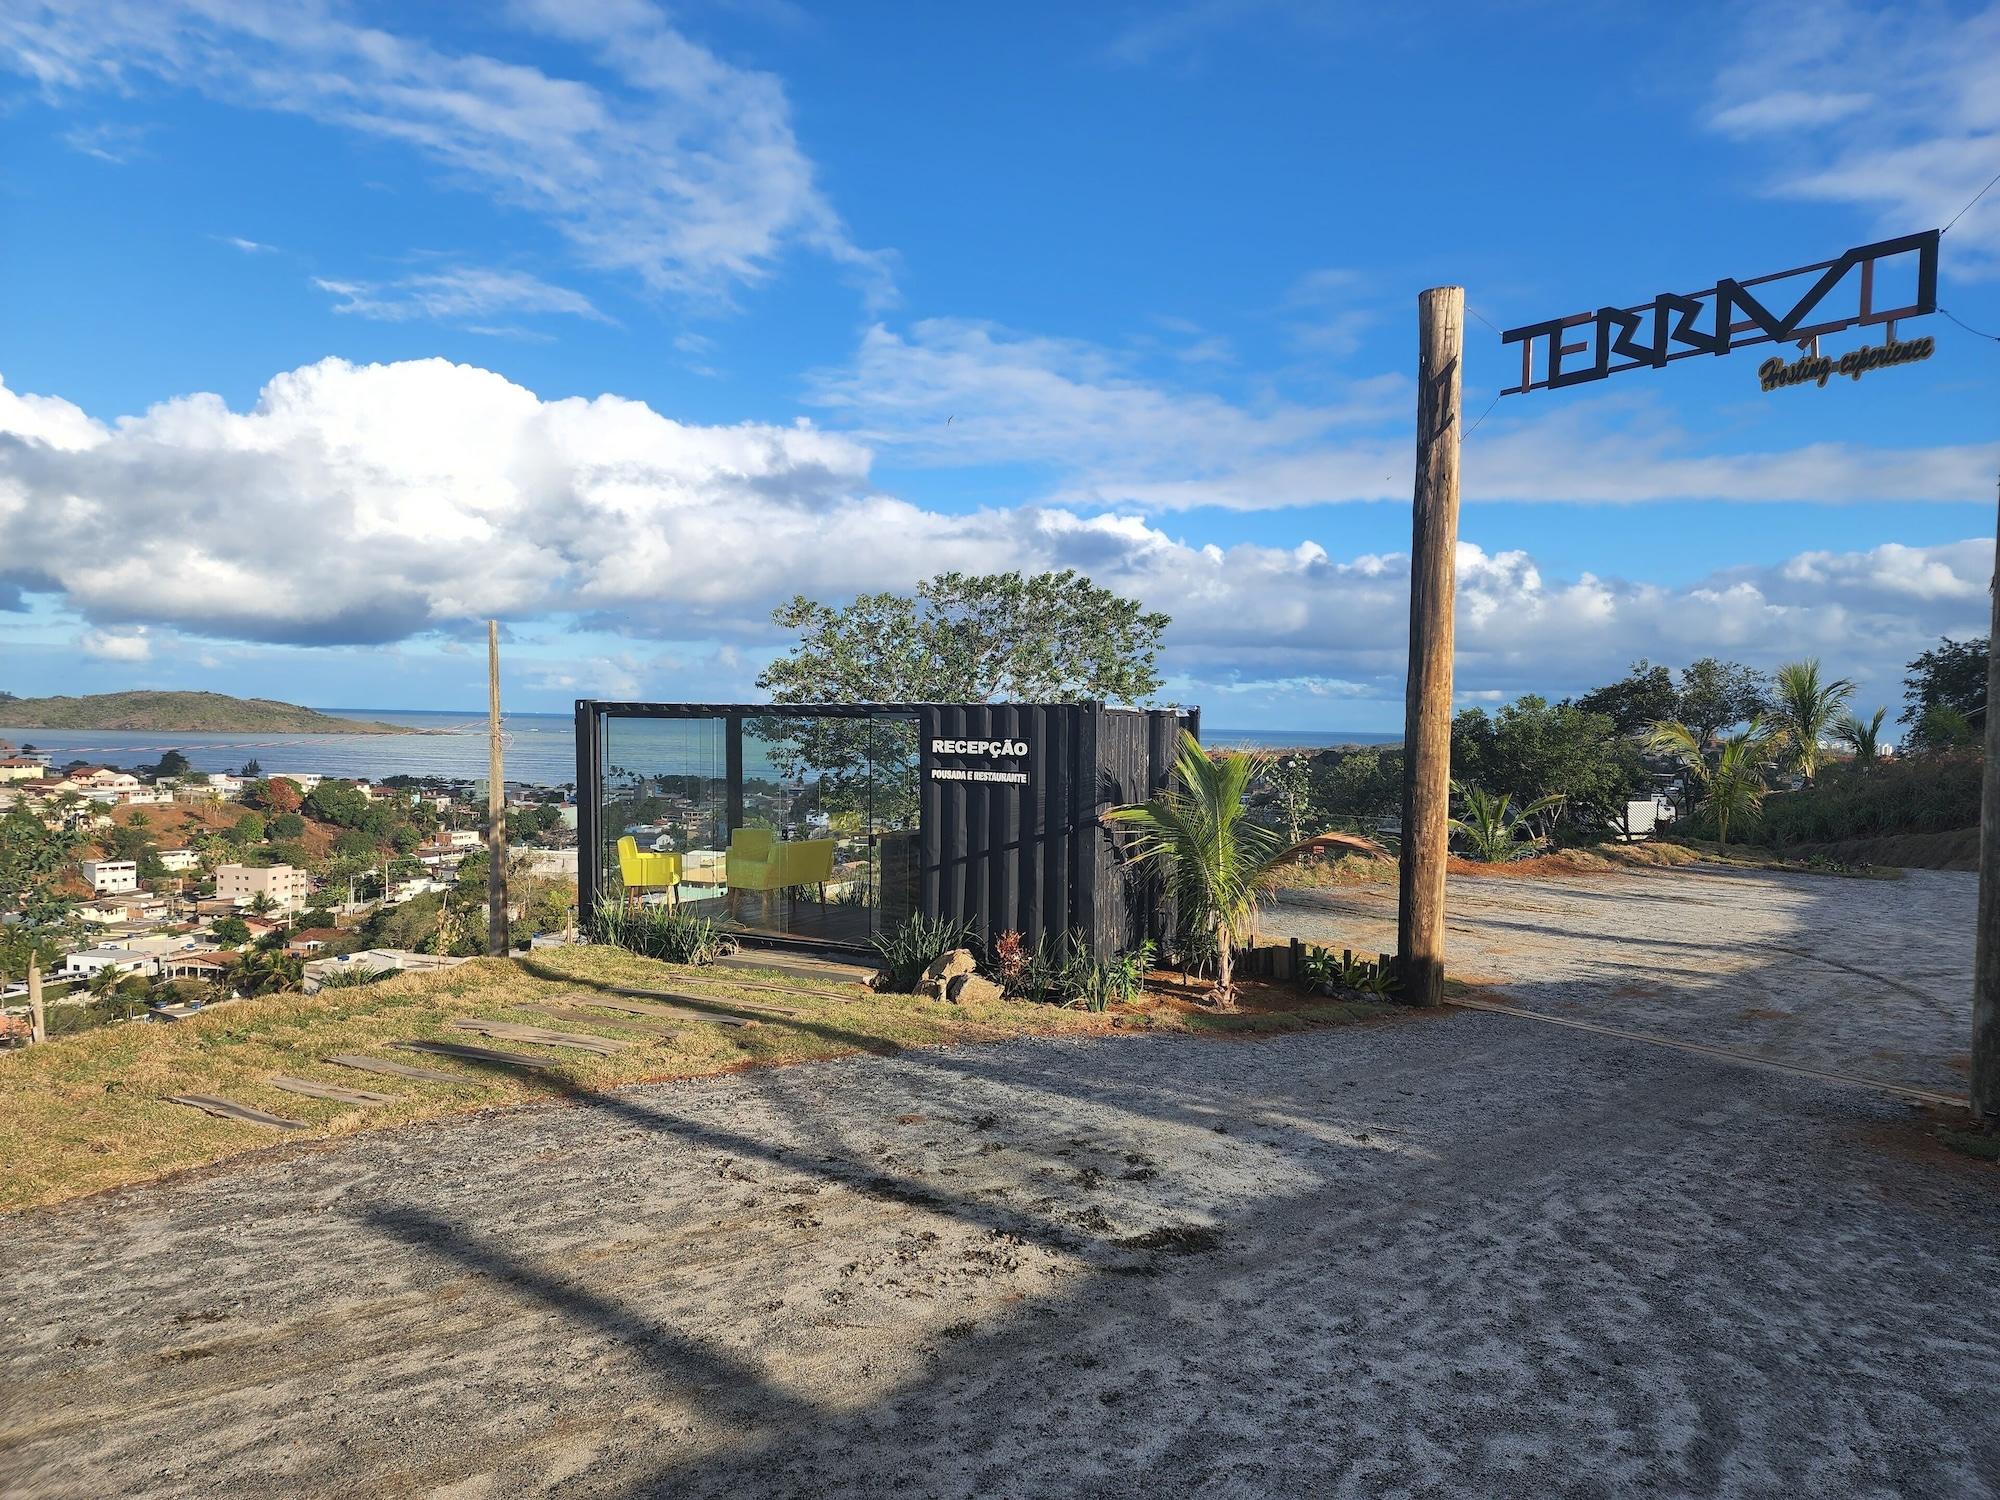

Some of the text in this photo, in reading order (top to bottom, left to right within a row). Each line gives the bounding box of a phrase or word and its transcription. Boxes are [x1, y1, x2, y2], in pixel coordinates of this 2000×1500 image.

[1758, 336, 1935, 391] Hosting experience
[932, 739, 1028, 758] RECEPÇÃO
[931, 769, 1027, 784] POUSADA E RESTAURANTE
